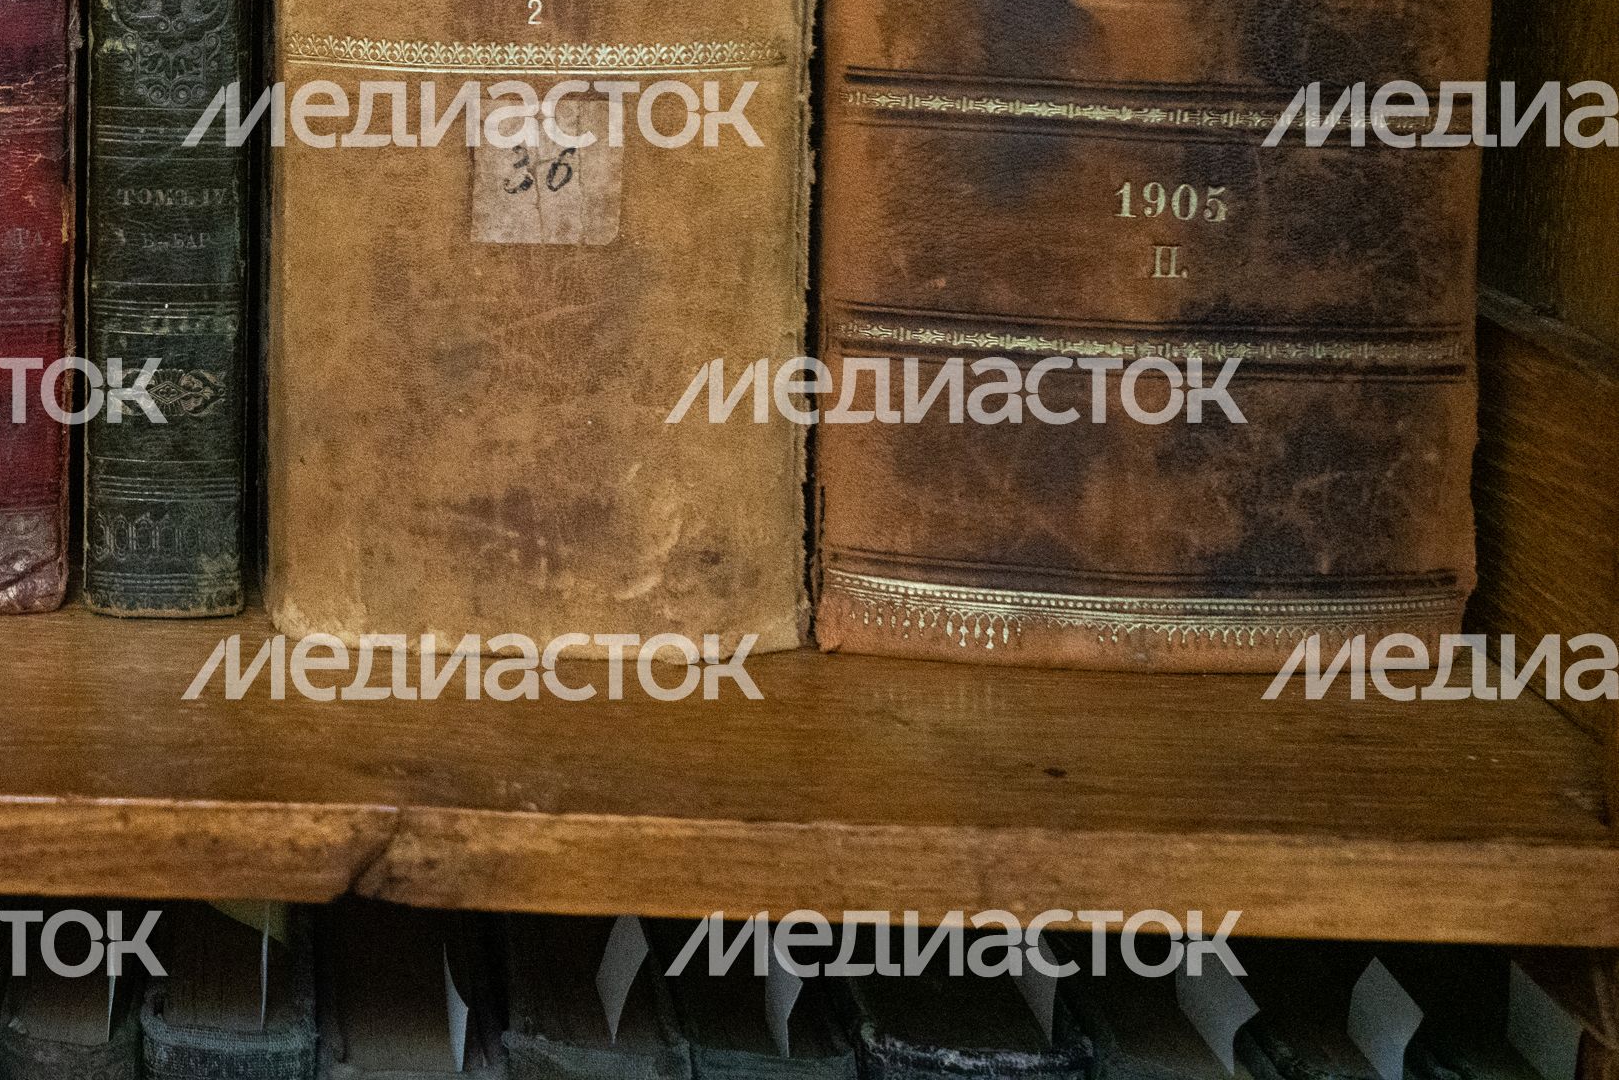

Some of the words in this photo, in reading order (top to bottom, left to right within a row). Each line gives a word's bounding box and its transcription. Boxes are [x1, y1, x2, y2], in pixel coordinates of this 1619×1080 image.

[526, 0, 543, 25] 2
[1113, 180, 1230, 223] 1905
[1150, 243, 1188, 281] II.
